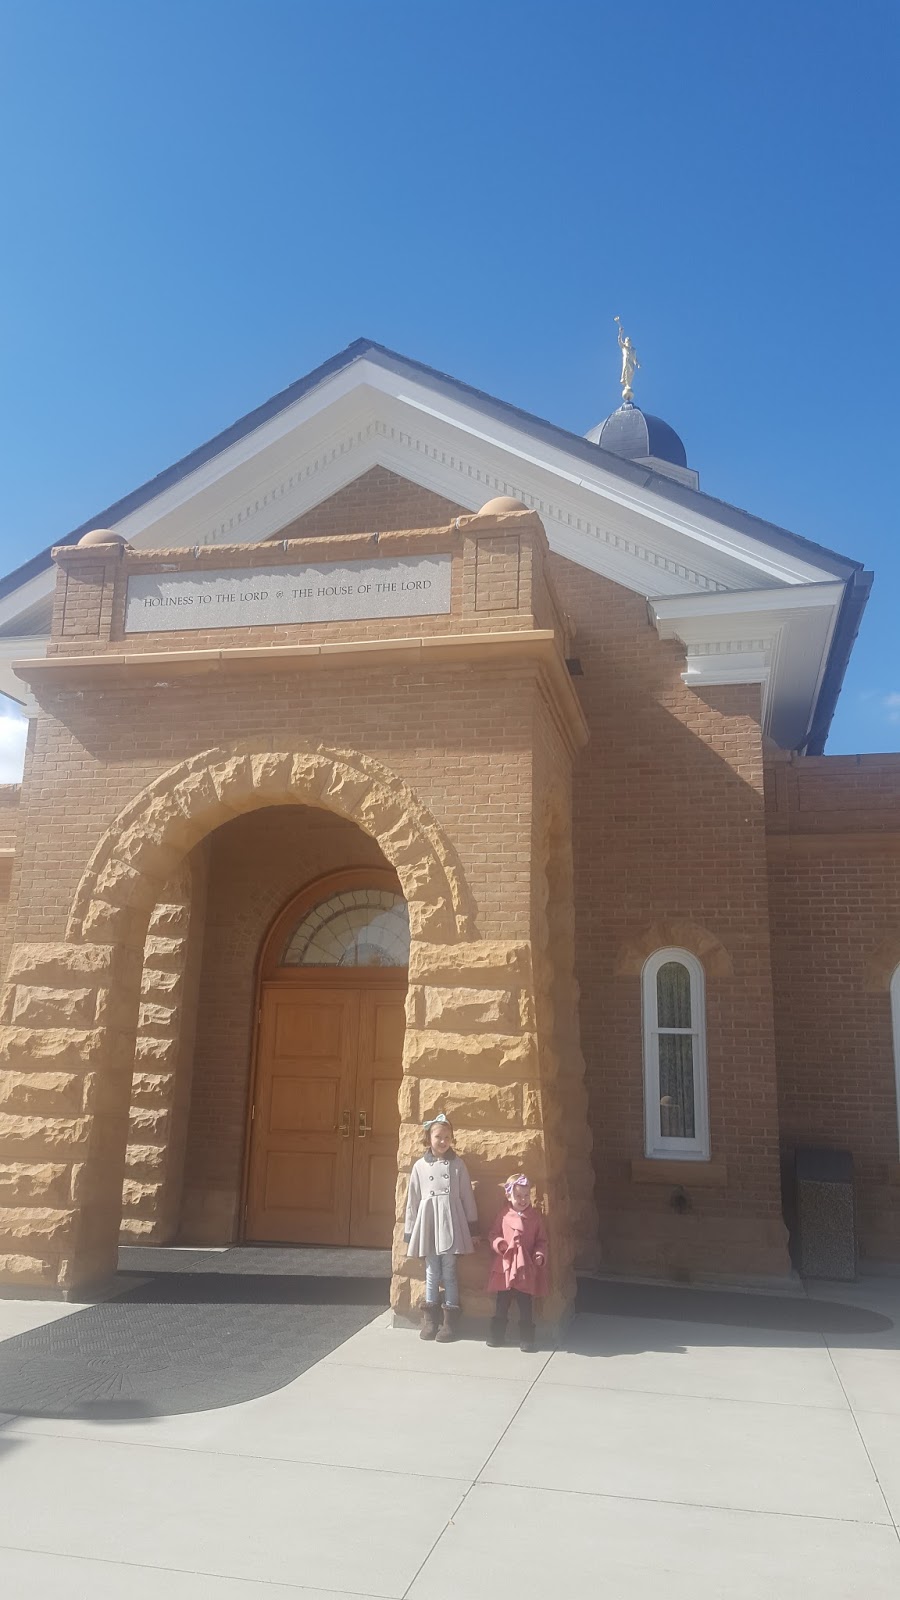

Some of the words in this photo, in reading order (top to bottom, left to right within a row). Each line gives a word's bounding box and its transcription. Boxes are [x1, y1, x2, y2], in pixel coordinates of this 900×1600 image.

[144, 596, 194, 607] HOLINESS
[197, 594, 212, 604] TO
[216, 593, 236, 603] THE
[240, 591, 269, 602] LORD
[292, 588, 313, 599] THE
[317, 586, 353, 597] HOUSE
[357, 584, 372, 594] OF
[375, 582, 397, 593] THE
[401, 580, 432, 591] LORD
